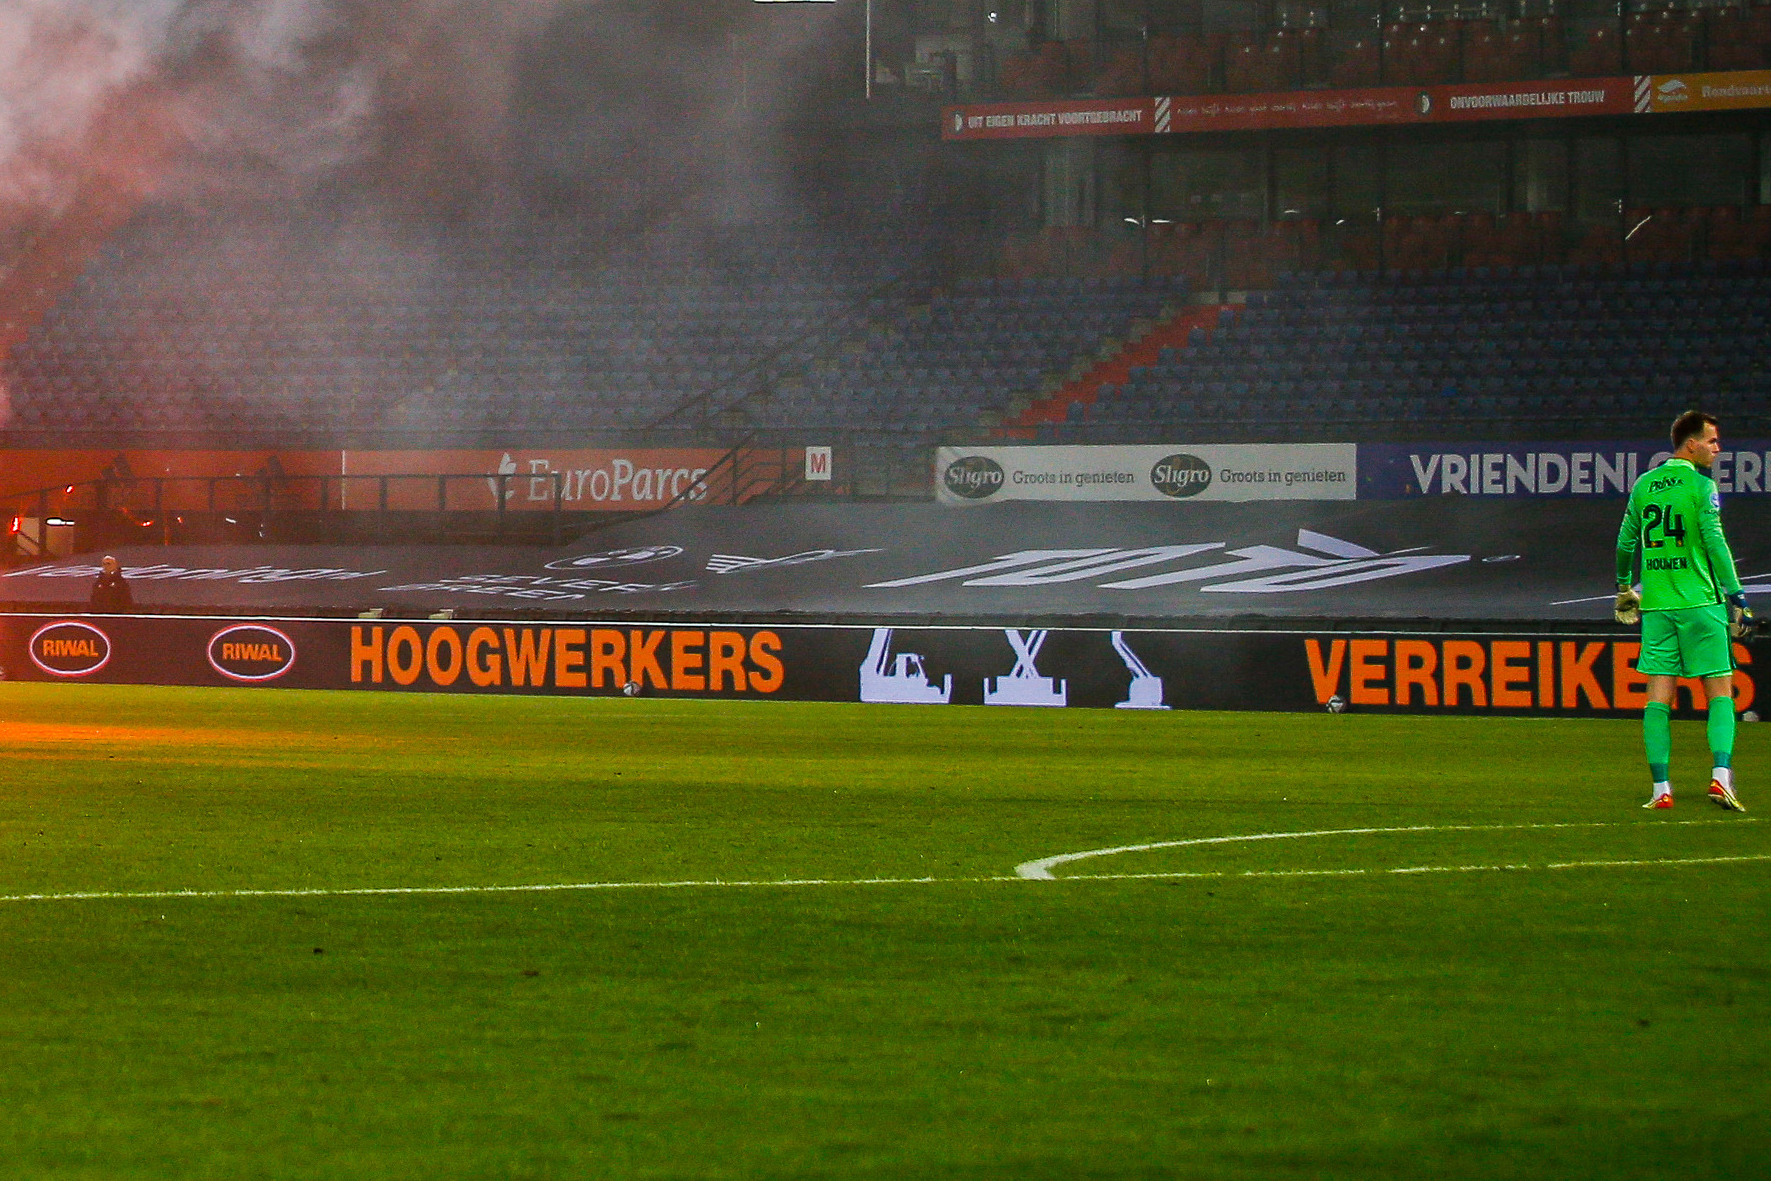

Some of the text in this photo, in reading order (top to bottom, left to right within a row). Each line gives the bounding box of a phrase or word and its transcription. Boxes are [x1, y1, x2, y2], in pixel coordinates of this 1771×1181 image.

[1449, 90, 1605, 109] ONVOORWAARDELIJKE TROUW
[810, 453, 826, 474] M
[527, 459, 709, 502] EuroParcs
[946, 466, 1003, 491] Sligro
[1012, 469, 1135, 488] Groots in genieten
[1150, 464, 1211, 490] Sligro
[1220, 469, 1346, 487] Groots in genieten
[1642, 503, 1685, 549] 24
[1646, 556, 1687, 570] HOUWEN
[42, 637, 99, 659] RIWAL
[221, 640, 283, 663] RIWAL
[349, 625, 785, 694] HOOGWERKERS
